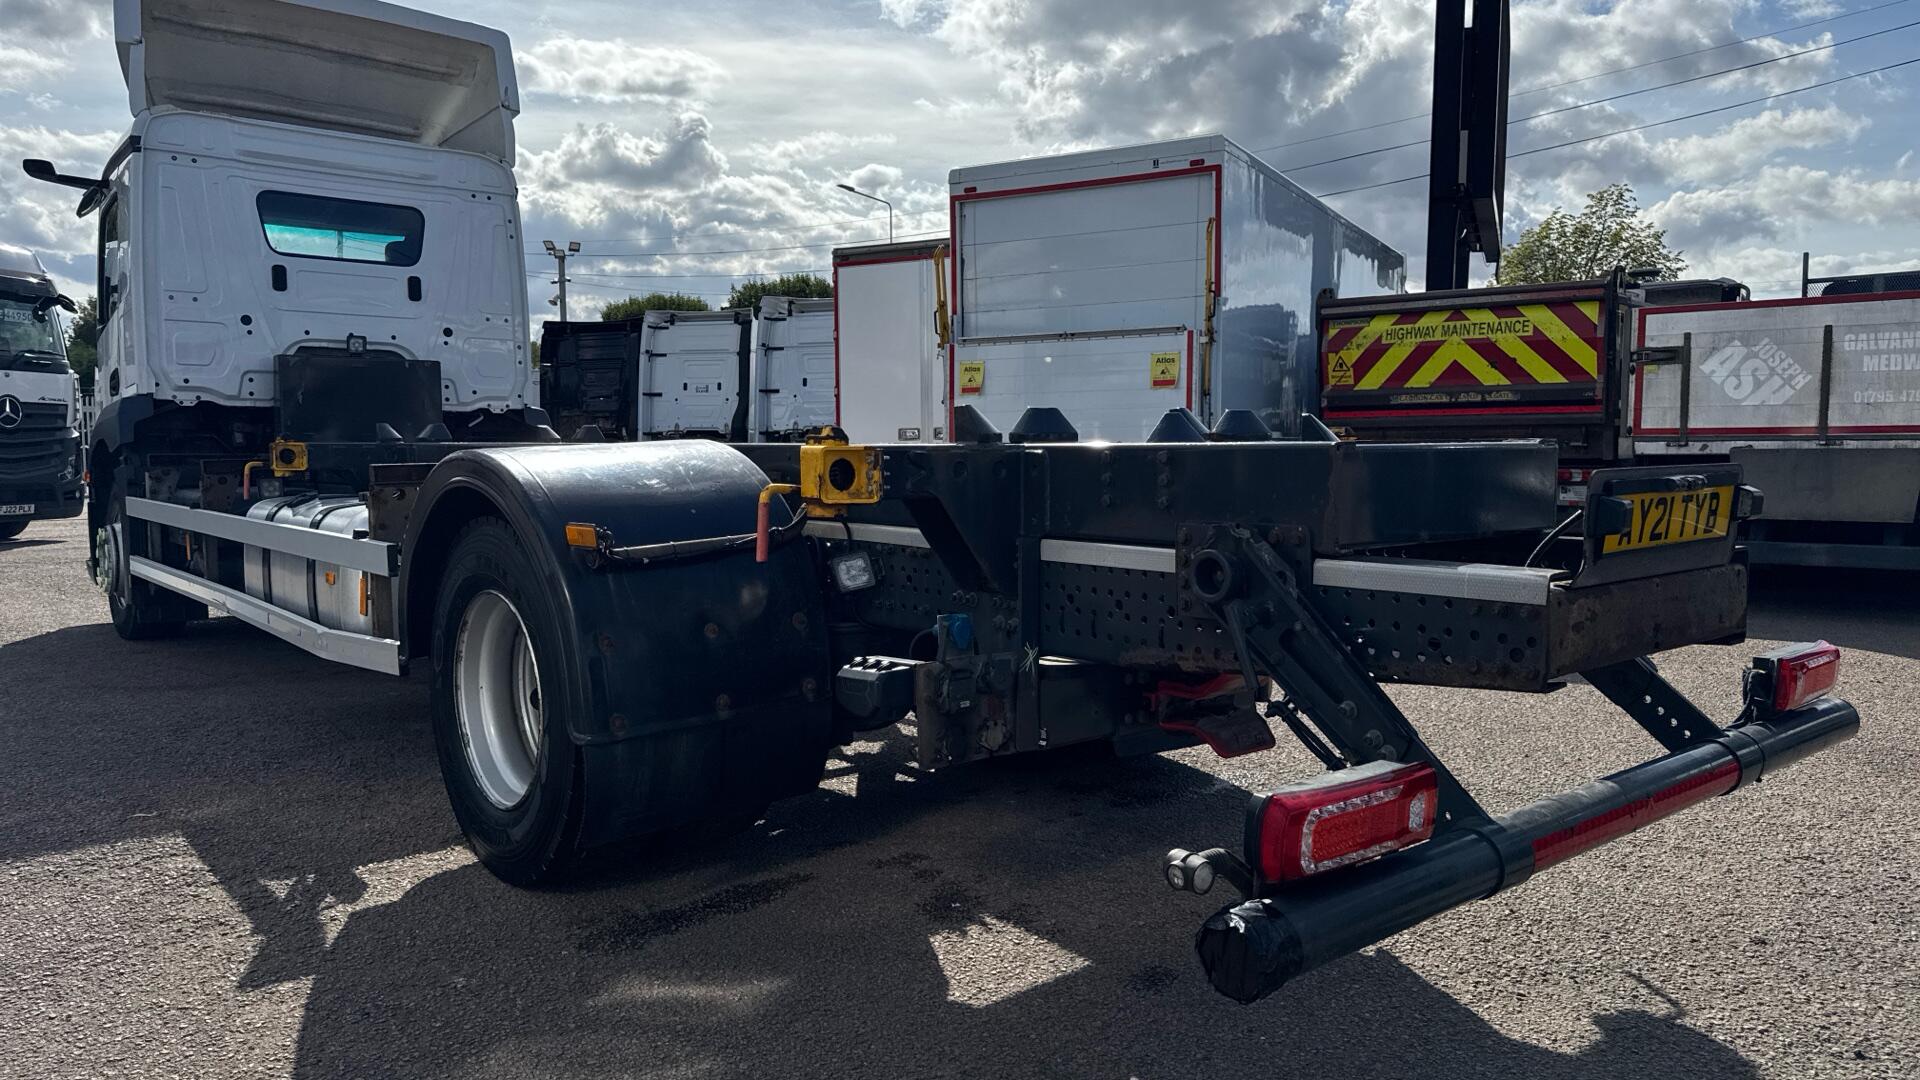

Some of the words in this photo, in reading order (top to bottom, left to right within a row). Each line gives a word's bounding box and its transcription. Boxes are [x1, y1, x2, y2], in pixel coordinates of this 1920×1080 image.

[1385, 325, 1439, 341] HIGHWAY
[1441, 319, 1530, 338] MAINTENANCE
[1699, 340, 1796, 405] ASH
[1752, 337, 1812, 391] JOSEPH
[1854, 389, 1893, 403] 01795
[1681, 492, 1720, 537] TYB
